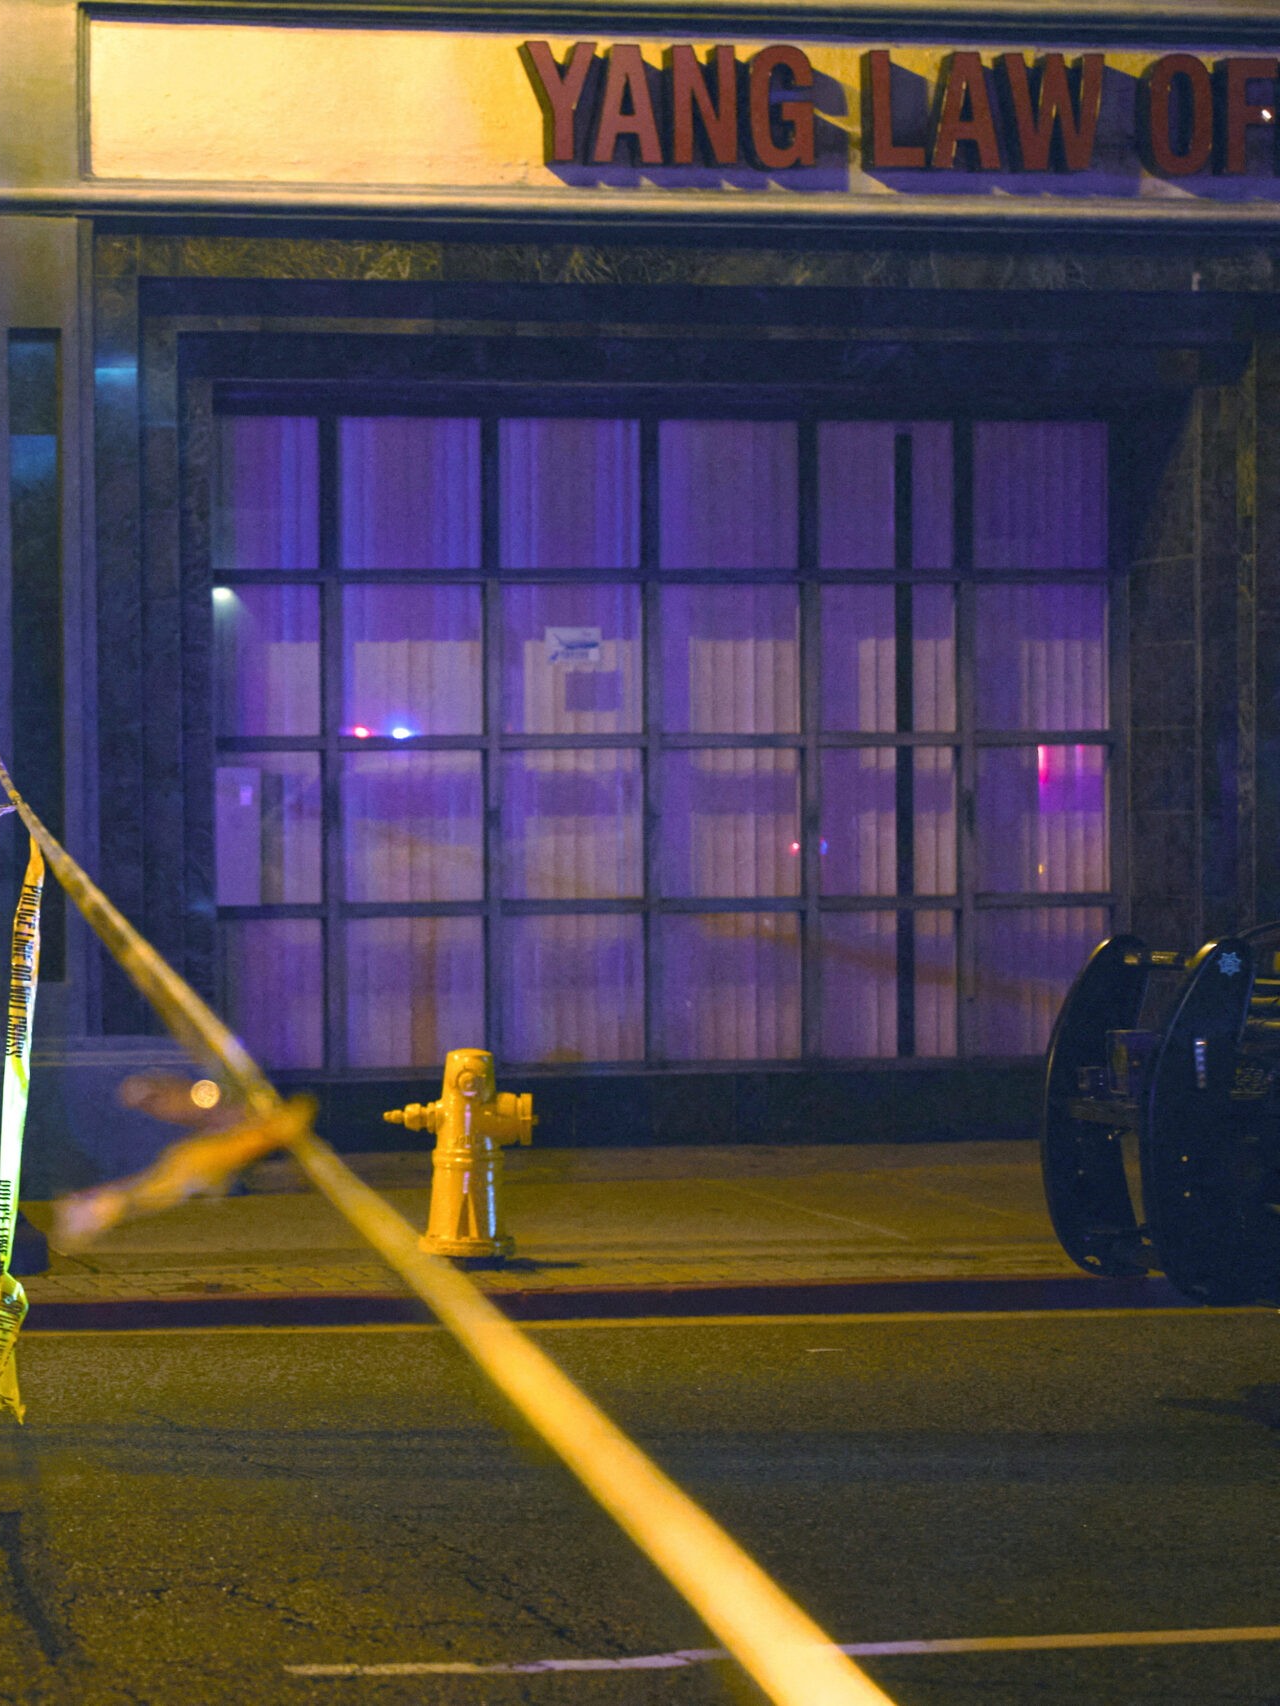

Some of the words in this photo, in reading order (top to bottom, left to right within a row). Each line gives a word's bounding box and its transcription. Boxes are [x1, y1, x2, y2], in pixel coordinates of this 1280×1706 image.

[519, 40, 816, 169] YANG
[860, 49, 1106, 172] LAW
[17, 884, 42, 928] POLICE
[13, 931, 36, 962] LINE
[8, 985, 32, 1014] NOT
[5, 1014, 28, 1058] CROSS
